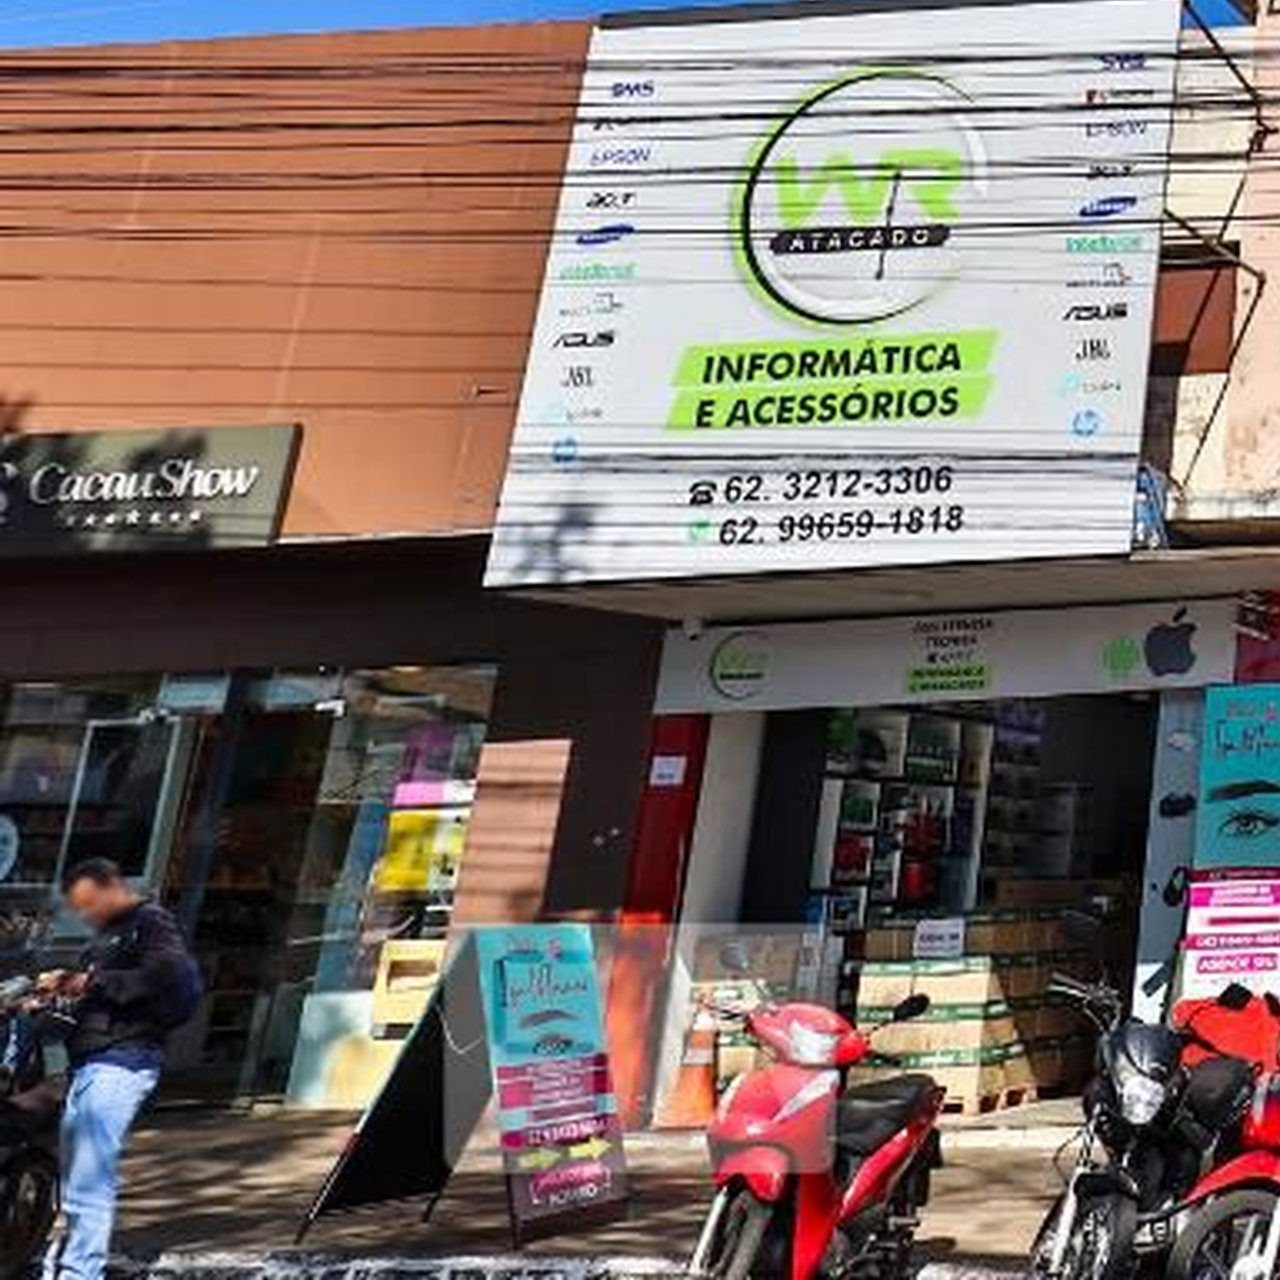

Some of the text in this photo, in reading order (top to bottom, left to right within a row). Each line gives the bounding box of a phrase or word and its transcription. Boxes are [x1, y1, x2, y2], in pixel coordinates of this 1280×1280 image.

[789, 228, 930, 252] ATACADO
[702, 340, 962, 384] INFORMÁTICA
[695, 384, 960, 429] E ACESSÓRIOS
[723, 465, 954, 504] 62. 3212-3306
[719, 505, 965, 546] 62. 99659-1818
